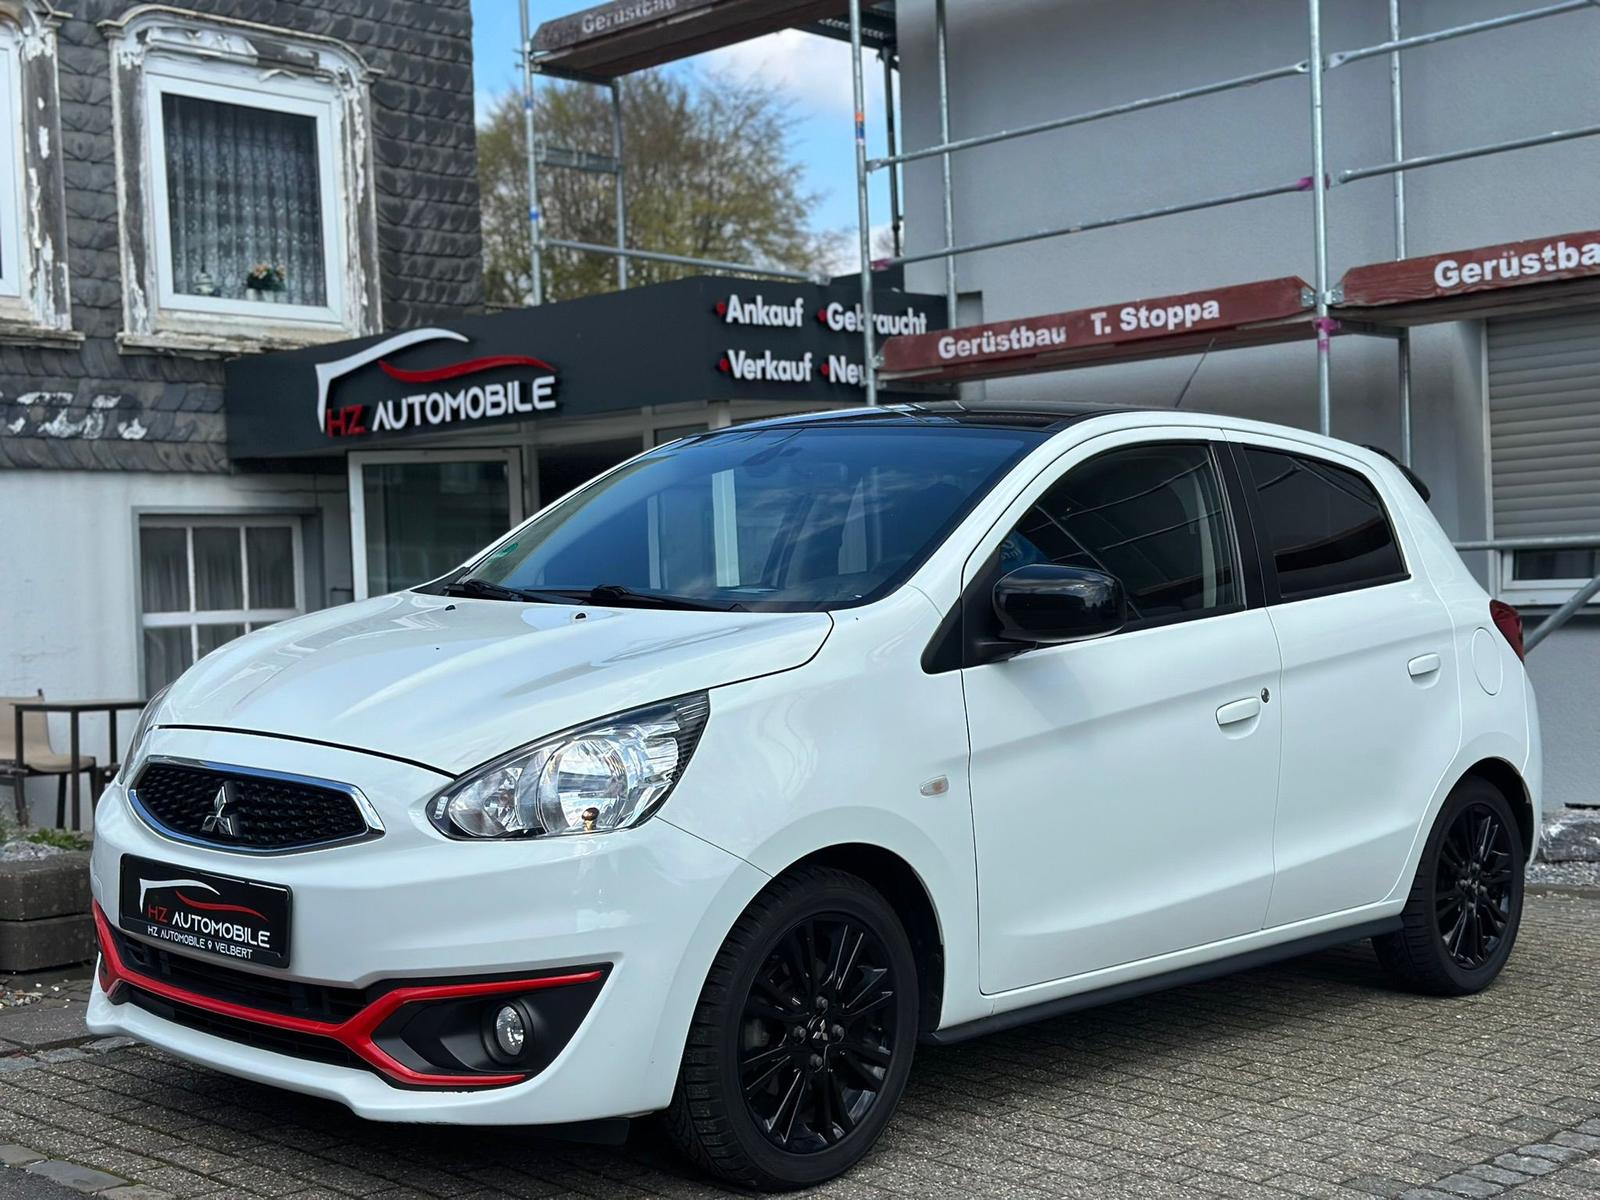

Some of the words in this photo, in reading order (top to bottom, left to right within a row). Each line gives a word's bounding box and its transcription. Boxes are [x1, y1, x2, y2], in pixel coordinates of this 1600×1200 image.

[725, 294, 804, 327] Ankauf
[938, 325, 1067, 360] Gerüstbau
[1090, 311, 1112, 336] T.
[1119, 299, 1220, 332] Stoppa
[727, 349, 812, 382] Verkauf
[326, 404, 366, 438] HZ
[372, 375, 557, 432] AUTOMOBILE
[147, 925, 158, 937] HZ
[160, 929, 205, 950] AUTOMOBILE
[215, 941, 253, 960] VELBERT
[148, 904, 168, 923] HZ
[172, 911, 271, 948] AUTOMOBILE
